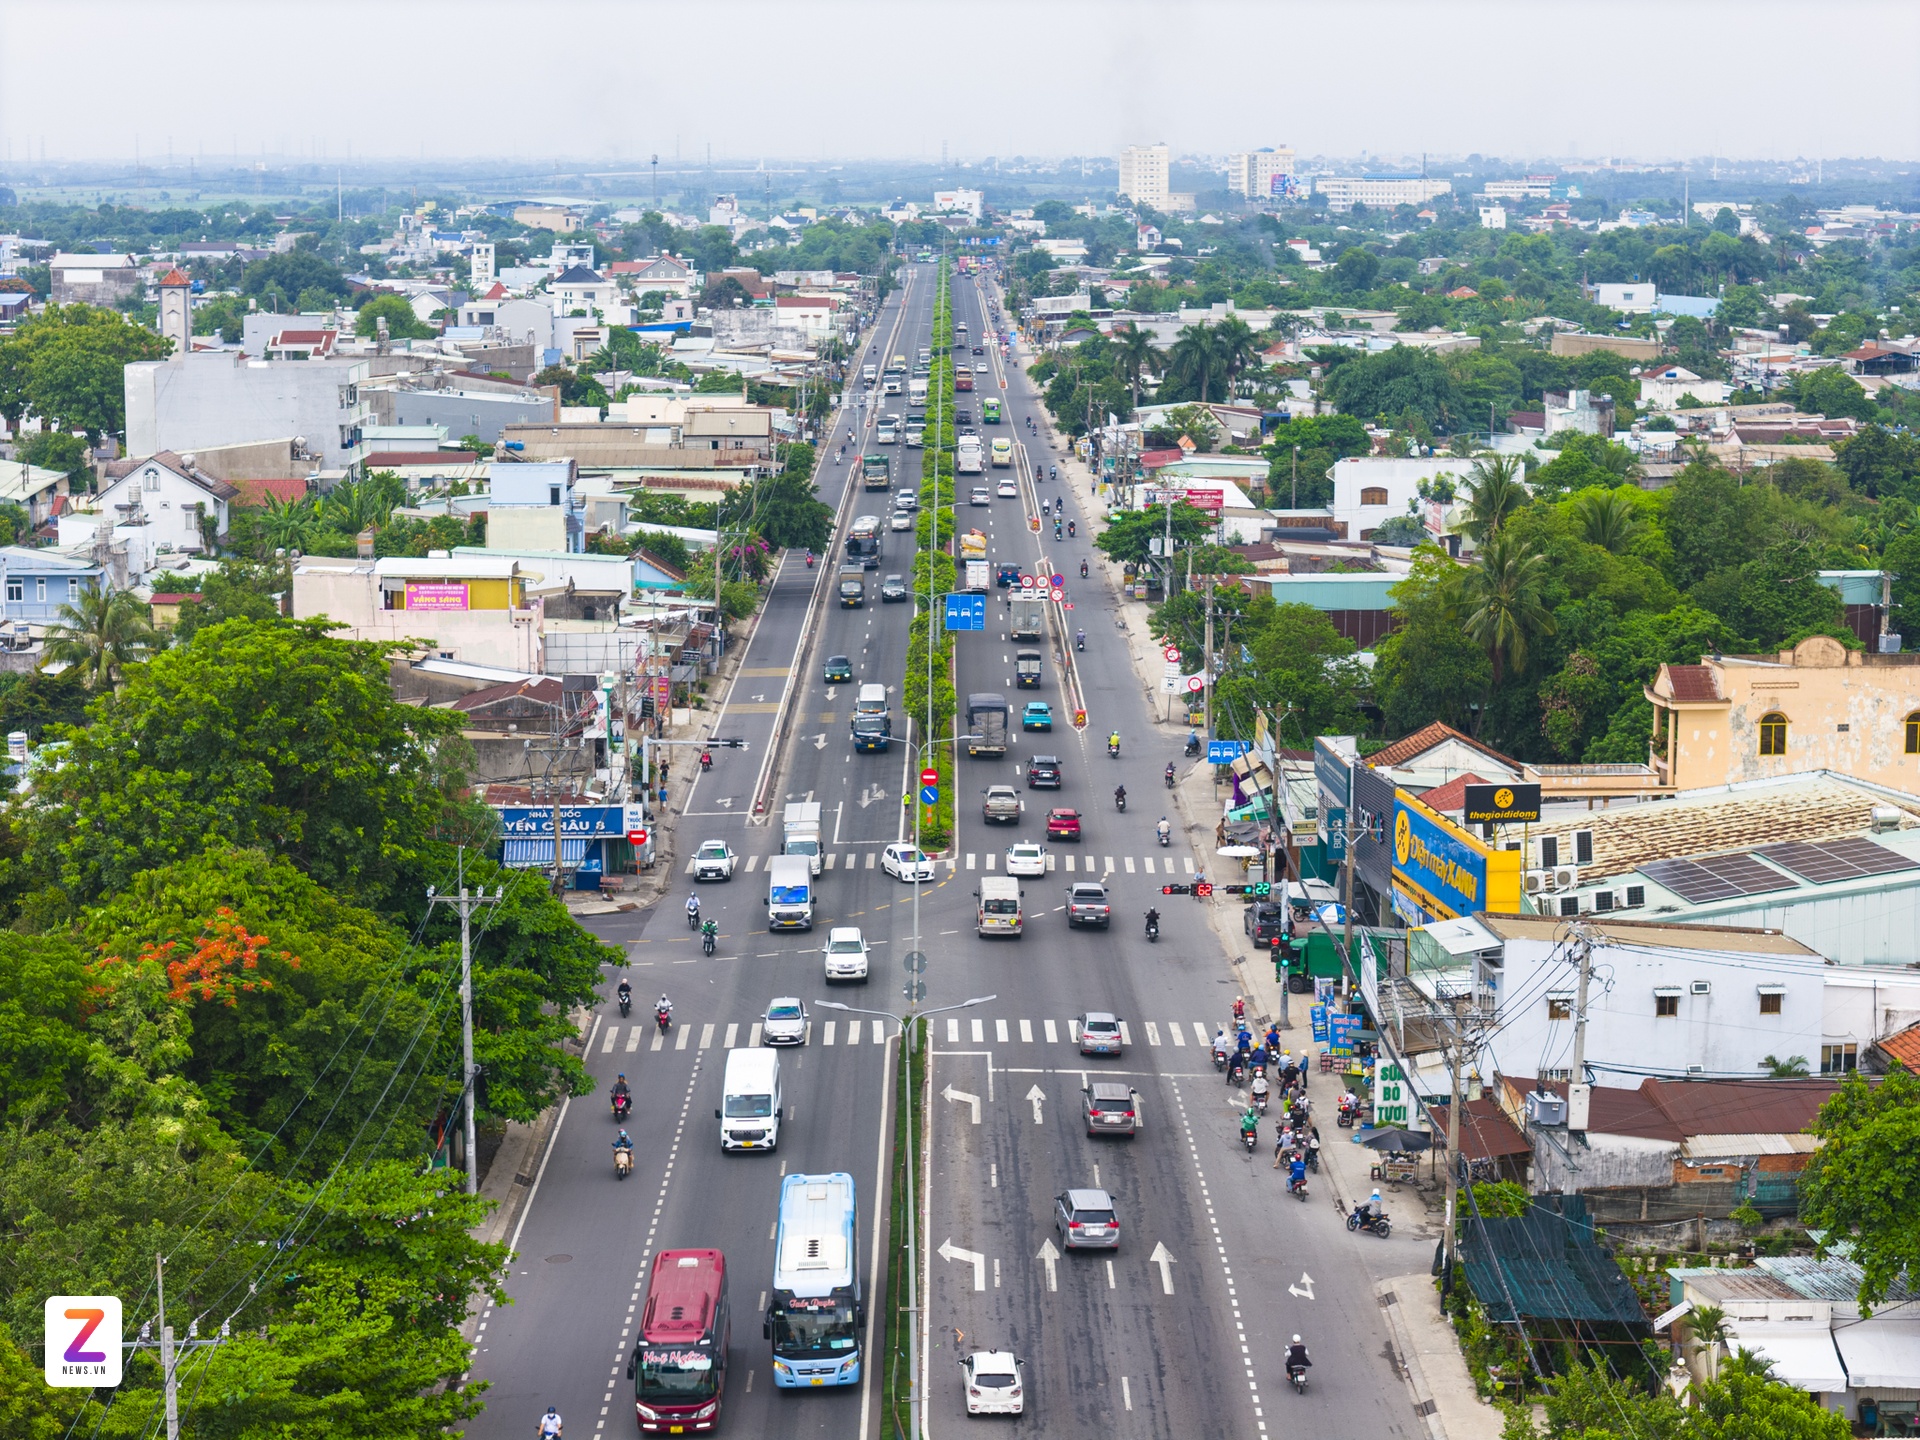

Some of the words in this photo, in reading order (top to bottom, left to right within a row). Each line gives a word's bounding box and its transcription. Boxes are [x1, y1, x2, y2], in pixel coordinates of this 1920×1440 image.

[529, 809, 549, 818] NHÀ
[1469, 810, 1538, 821] thegioididong
[505, 817, 537, 832] YẾN
[1410, 834, 1430, 869] Điện
[1429, 853, 1449, 887] máy
[1446, 859, 1478, 903] XANH
[1197, 884, 1212, 896] 62
[1255, 883, 1270, 895] 22
[1383, 1083, 1401, 1101] BÒ
[1377, 1105, 1407, 1121] TƯƠI
